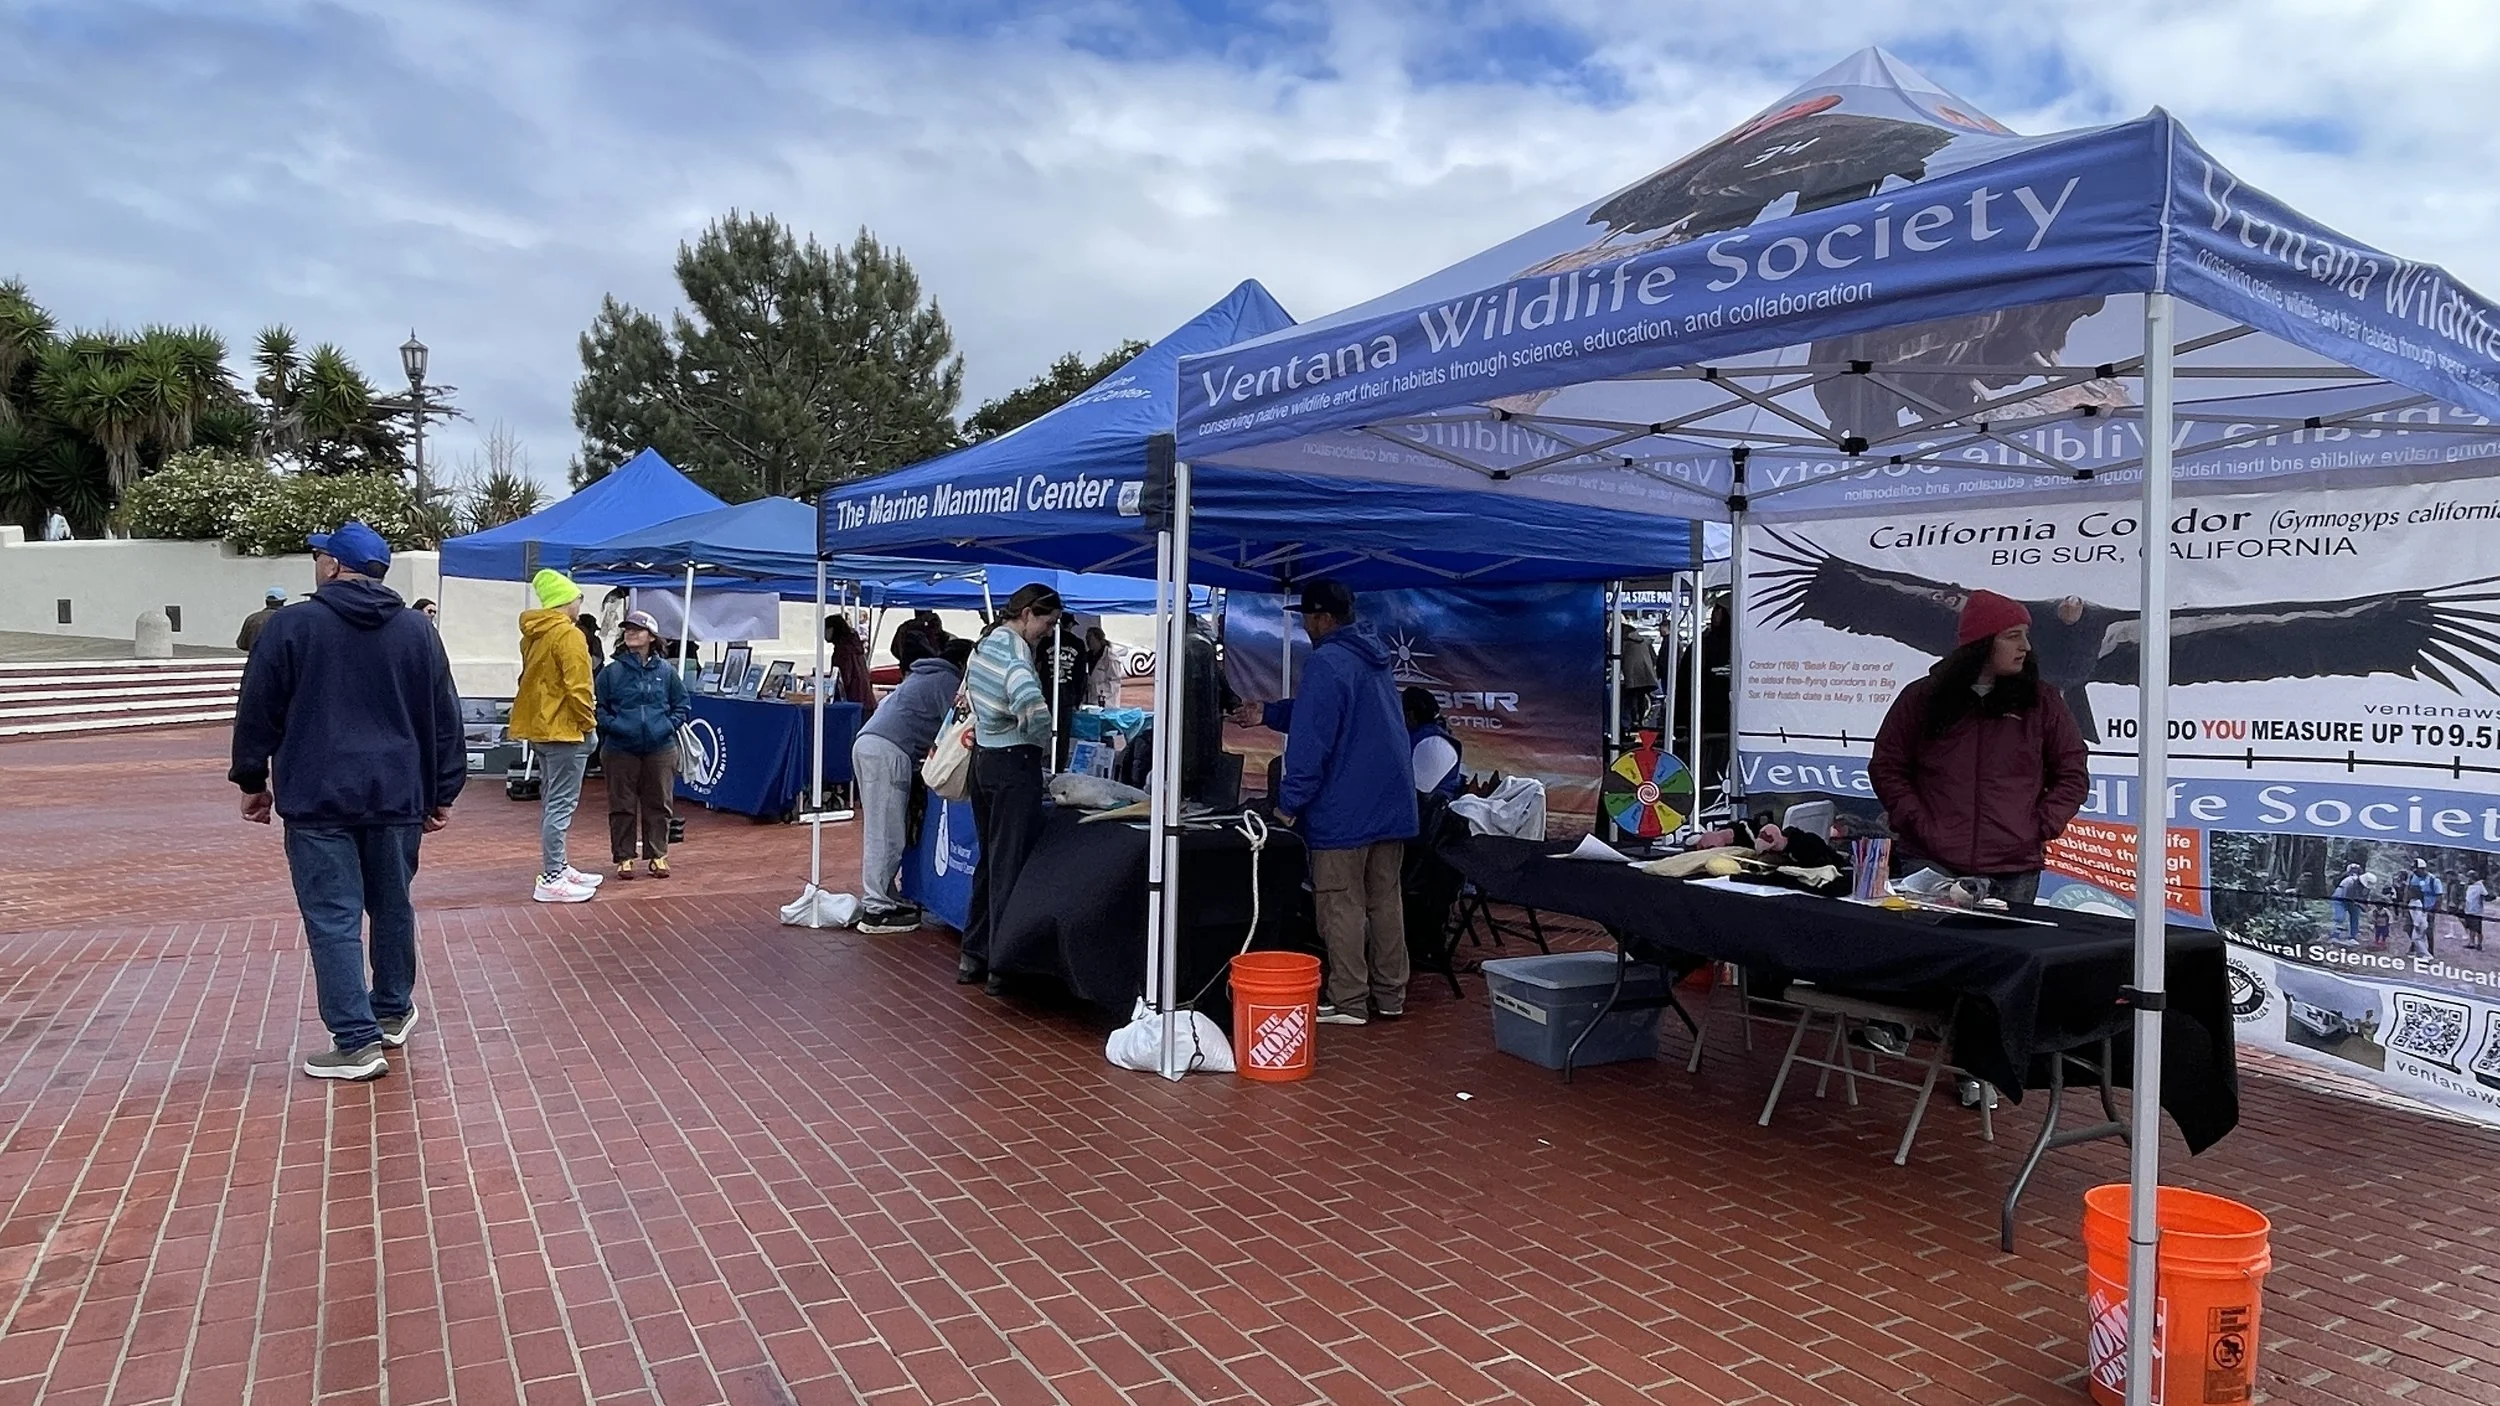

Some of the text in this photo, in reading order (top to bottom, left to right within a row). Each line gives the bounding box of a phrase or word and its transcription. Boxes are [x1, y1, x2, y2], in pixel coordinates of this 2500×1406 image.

[1743, 137, 1821, 169] 34
[2202, 160, 2379, 300] Ventana
[1202, 177, 2080, 407] Ventana Wildlife Society
[1199, 281, 1873, 436] conserving native wildlife and their habitats through science, education, and collaboration
[836, 472, 1115, 530] The Marine Mammal Center
[1869, 518, 2056, 550] California
[2077, 507, 2252, 538] Codor
[2268, 508, 2400, 534] (Gymnogyps
[1991, 536, 2358, 566] BIG SUR, ALIFORNIA
[1657, 591, 1682, 603] PAR
[1748, 660, 1776, 670] Condor
[1852, 661, 1860, 671] is
[1862, 663, 1880, 671] one
[1882, 661, 1894, 671] of
[1829, 678, 1866, 687] condors
[1868, 677, 1878, 687] in
[1880, 678, 1896, 689] Big
[1834, 692, 1854, 703] May
[1868, 693, 1892, 703] 1997
[2107, 718, 2138, 739] HO
[2167, 719, 2197, 740] DO
[2201, 719, 2246, 740] YOU
[2252, 720, 2363, 742] MEASURE
[2372, 723, 2404, 744] UP
[2412, 724, 2444, 746] TO
[1738, 755, 1873, 791] Venta
[2066, 822, 2117, 842] native
[2224, 930, 2302, 958] Natural
[2308, 944, 2406, 971] Science
[1249, 1006, 1306, 1067] HOME
[1255, 1013, 1283, 1038] THE
